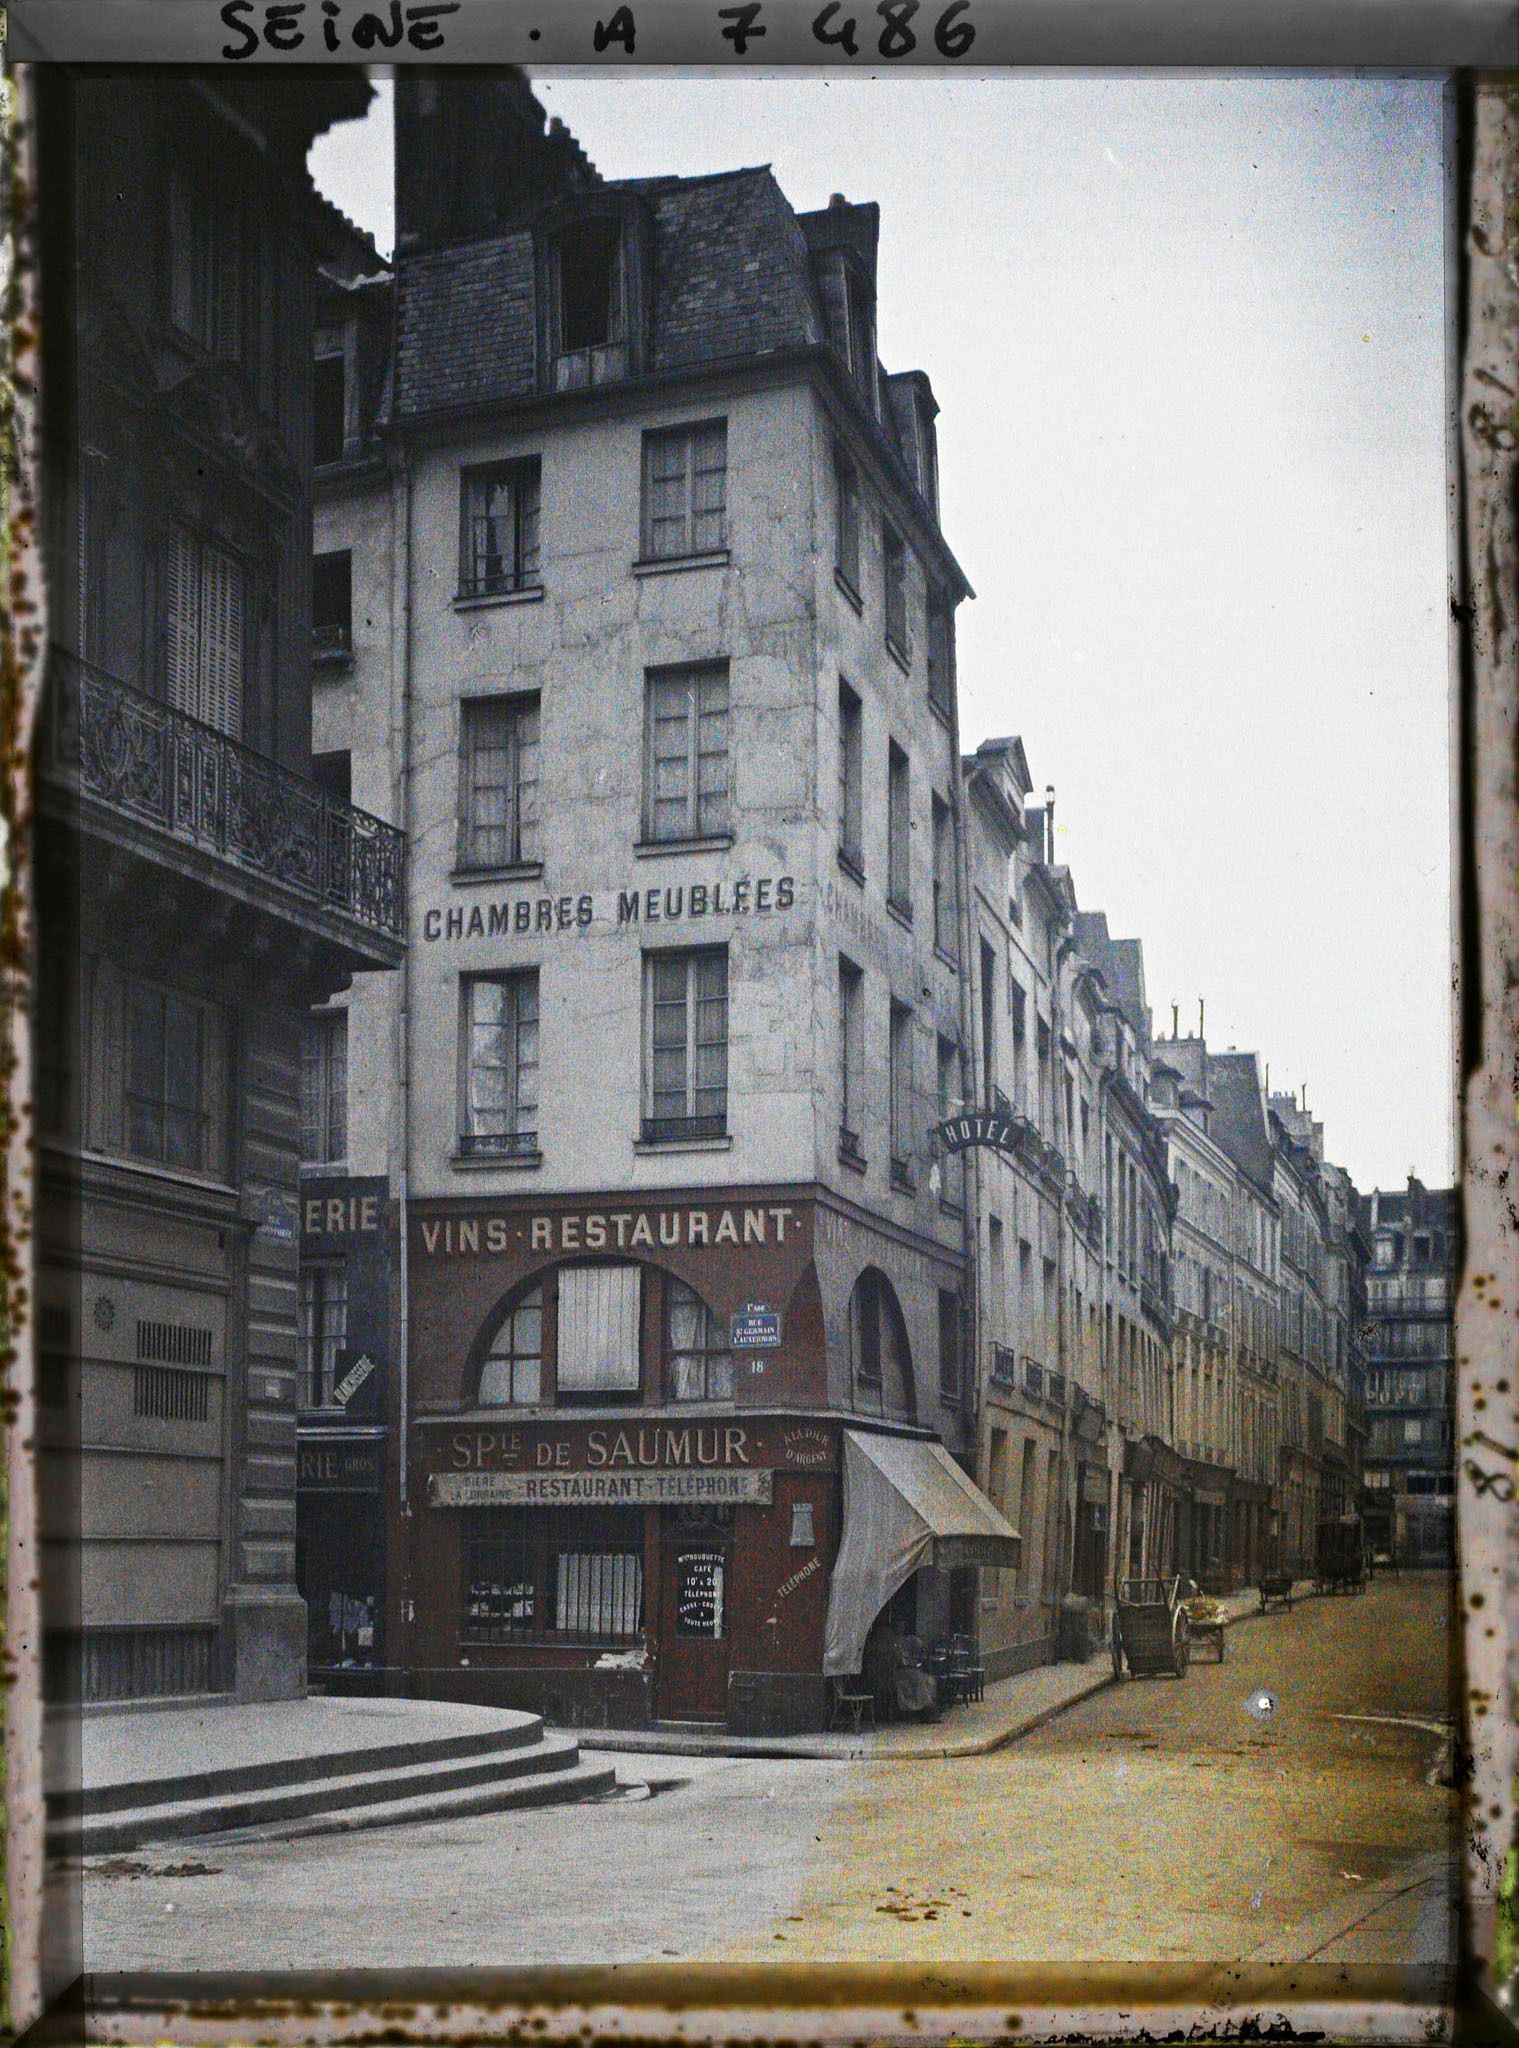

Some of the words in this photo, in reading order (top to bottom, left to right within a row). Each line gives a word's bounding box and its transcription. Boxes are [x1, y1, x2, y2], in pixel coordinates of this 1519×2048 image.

[594, 4, 635, 53] A
[719, 12, 766, 54] 7
[423, 896, 593, 942] CHAMBRES
[945, 1118, 1009, 1145] HOTEL
[420, 1218, 507, 1254] VINS
[531, 1207, 792, 1250] RESTAURANT
[751, 1359, 764, 1374] 18
[536, 1442, 572, 1467] DE
[587, 1427, 750, 1468] SAUMUR
[526, 1477, 644, 1499] RESTAURANT
